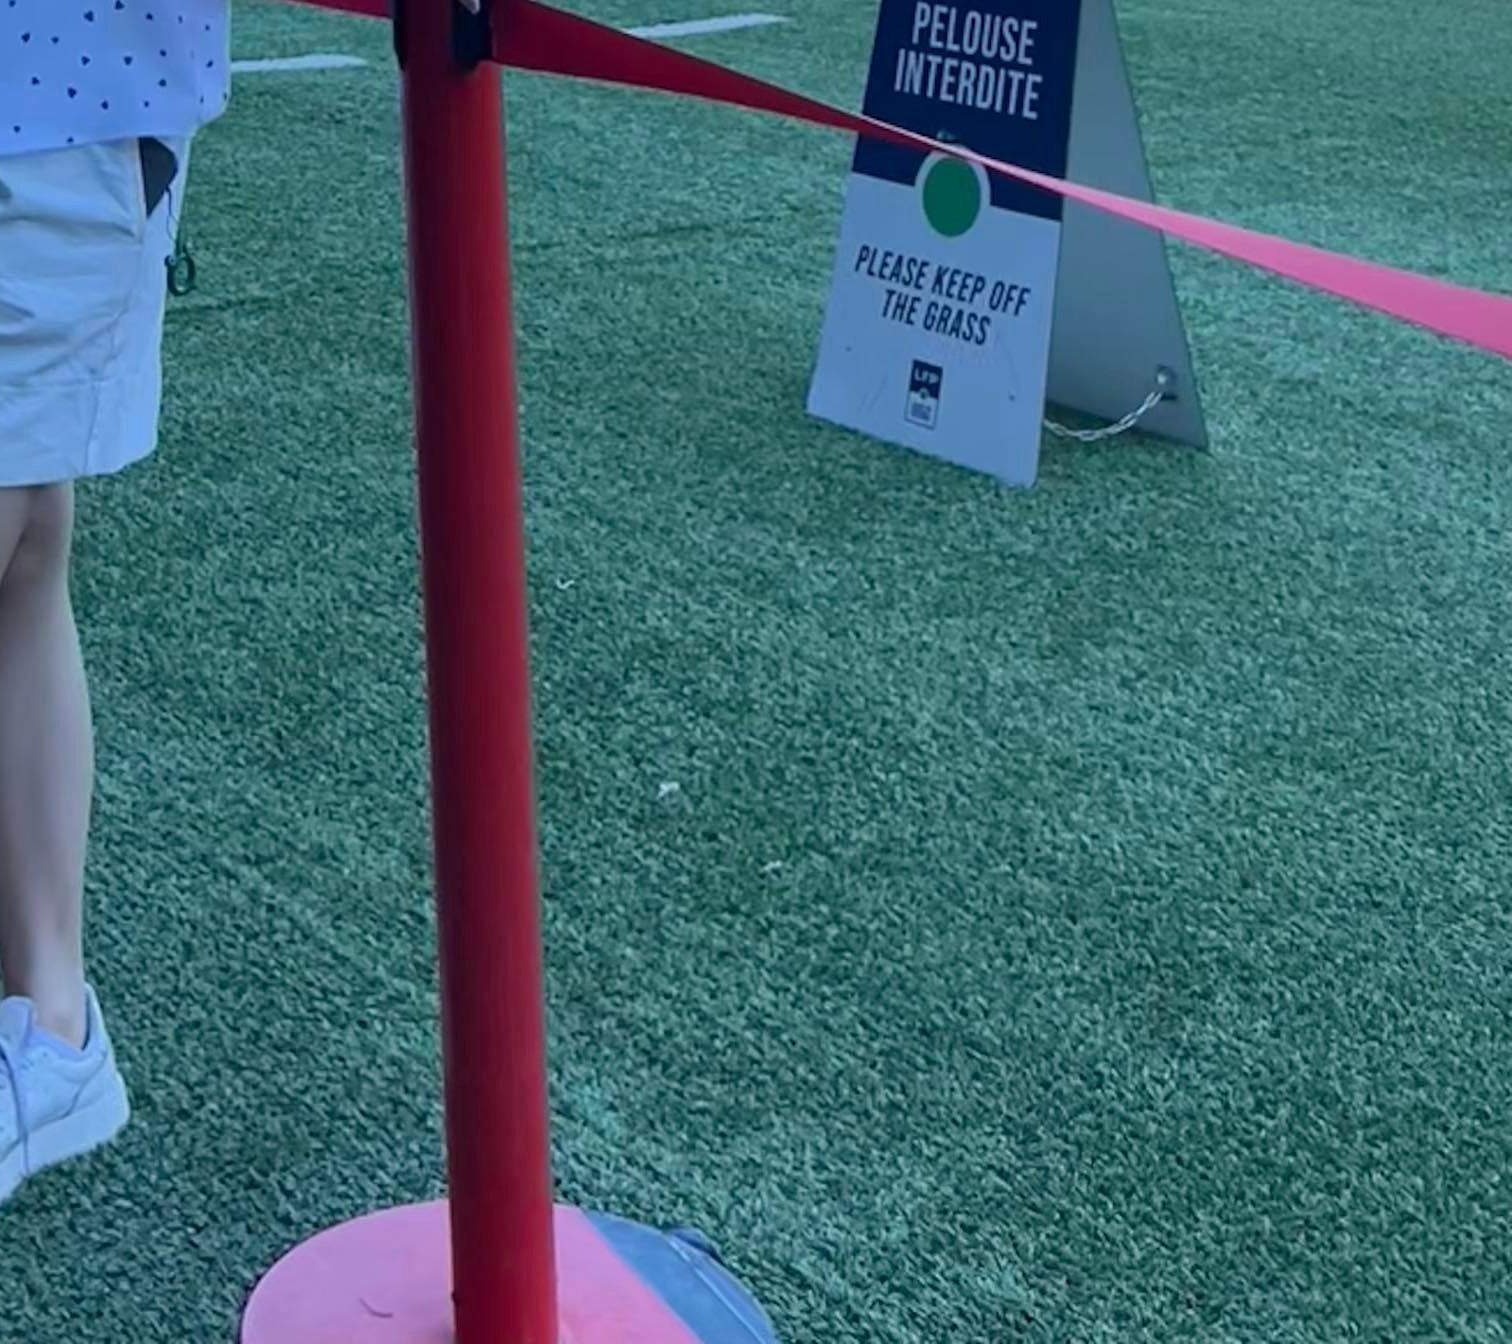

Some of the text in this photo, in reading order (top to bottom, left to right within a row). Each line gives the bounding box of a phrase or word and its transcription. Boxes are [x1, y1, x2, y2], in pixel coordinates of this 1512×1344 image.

[912, 1, 1038, 66] PELOUSE
[893, 48, 1043, 120] INTERDITE
[854, 244, 1031, 317] PLEASE KEEP OFF
[882, 288, 991, 346] THE GRASS
